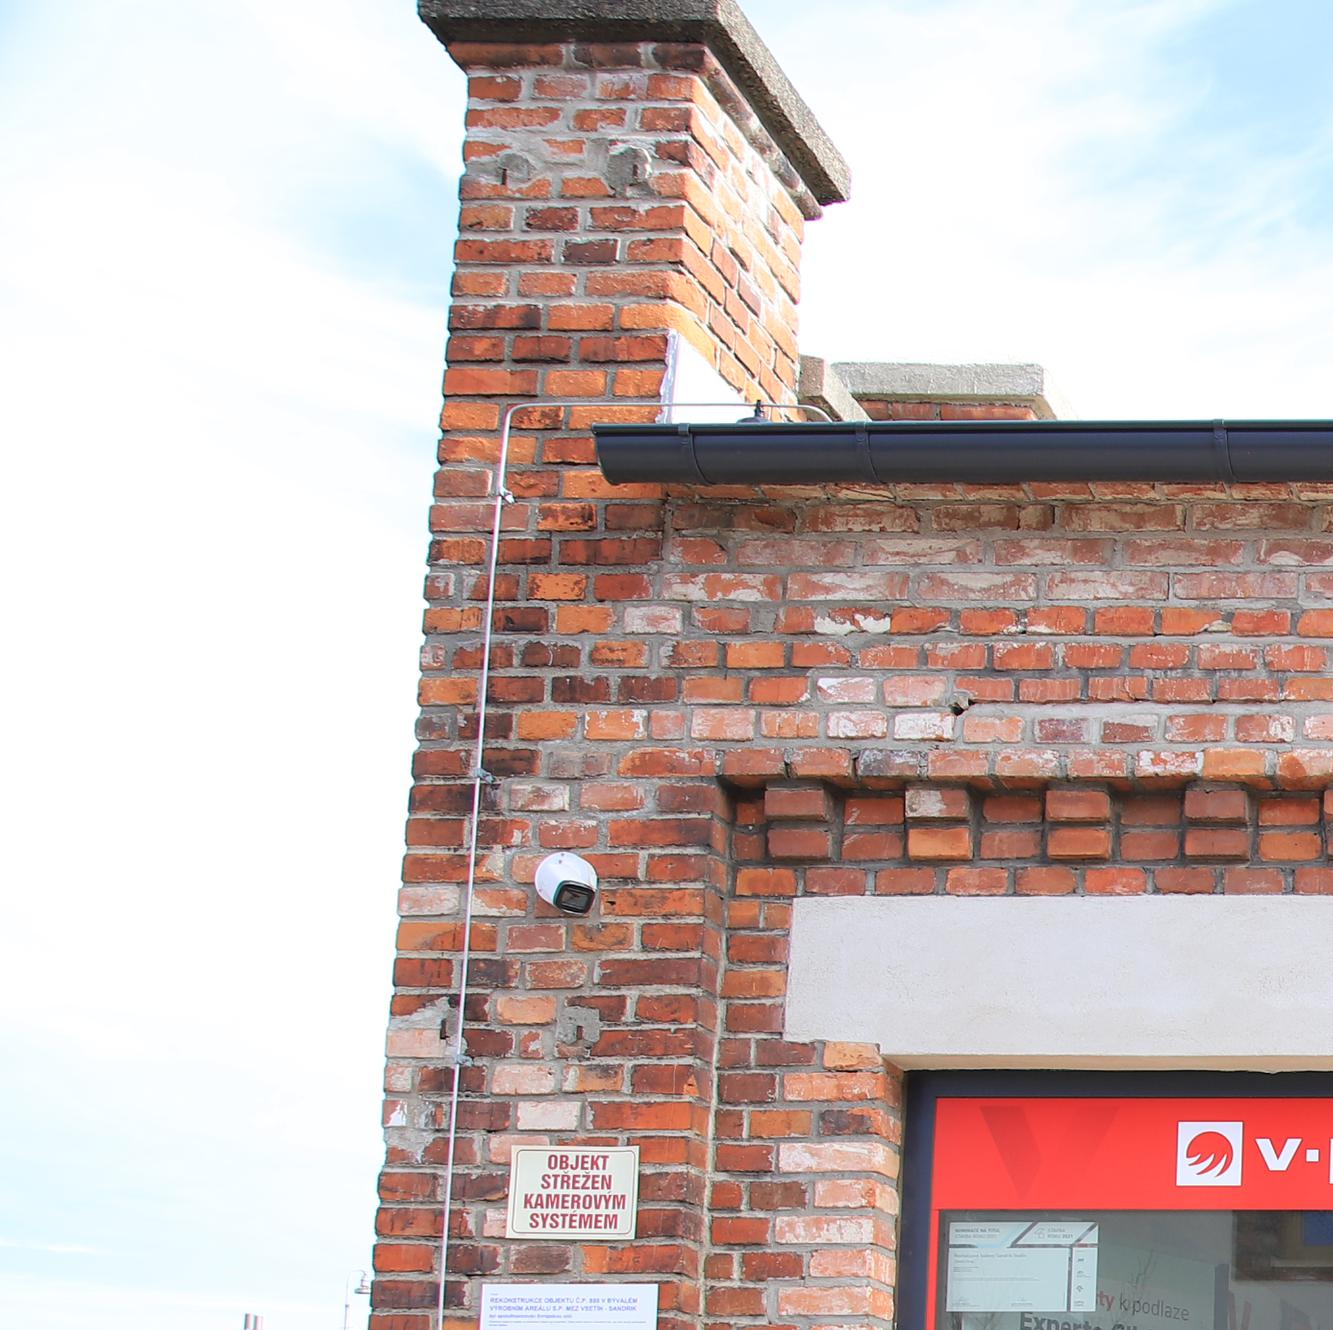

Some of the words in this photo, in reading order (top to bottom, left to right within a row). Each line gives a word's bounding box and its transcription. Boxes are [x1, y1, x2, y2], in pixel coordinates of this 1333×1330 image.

[547, 1154, 609, 1170] OBJEKT
[541, 1170, 612, 1190] STŘEŽEN
[523, 1191, 626, 1210] KAMEROVÝM
[529, 1210, 618, 1230] SYSTÉMEM
[1132, 1296, 1190, 1321] podlaze
